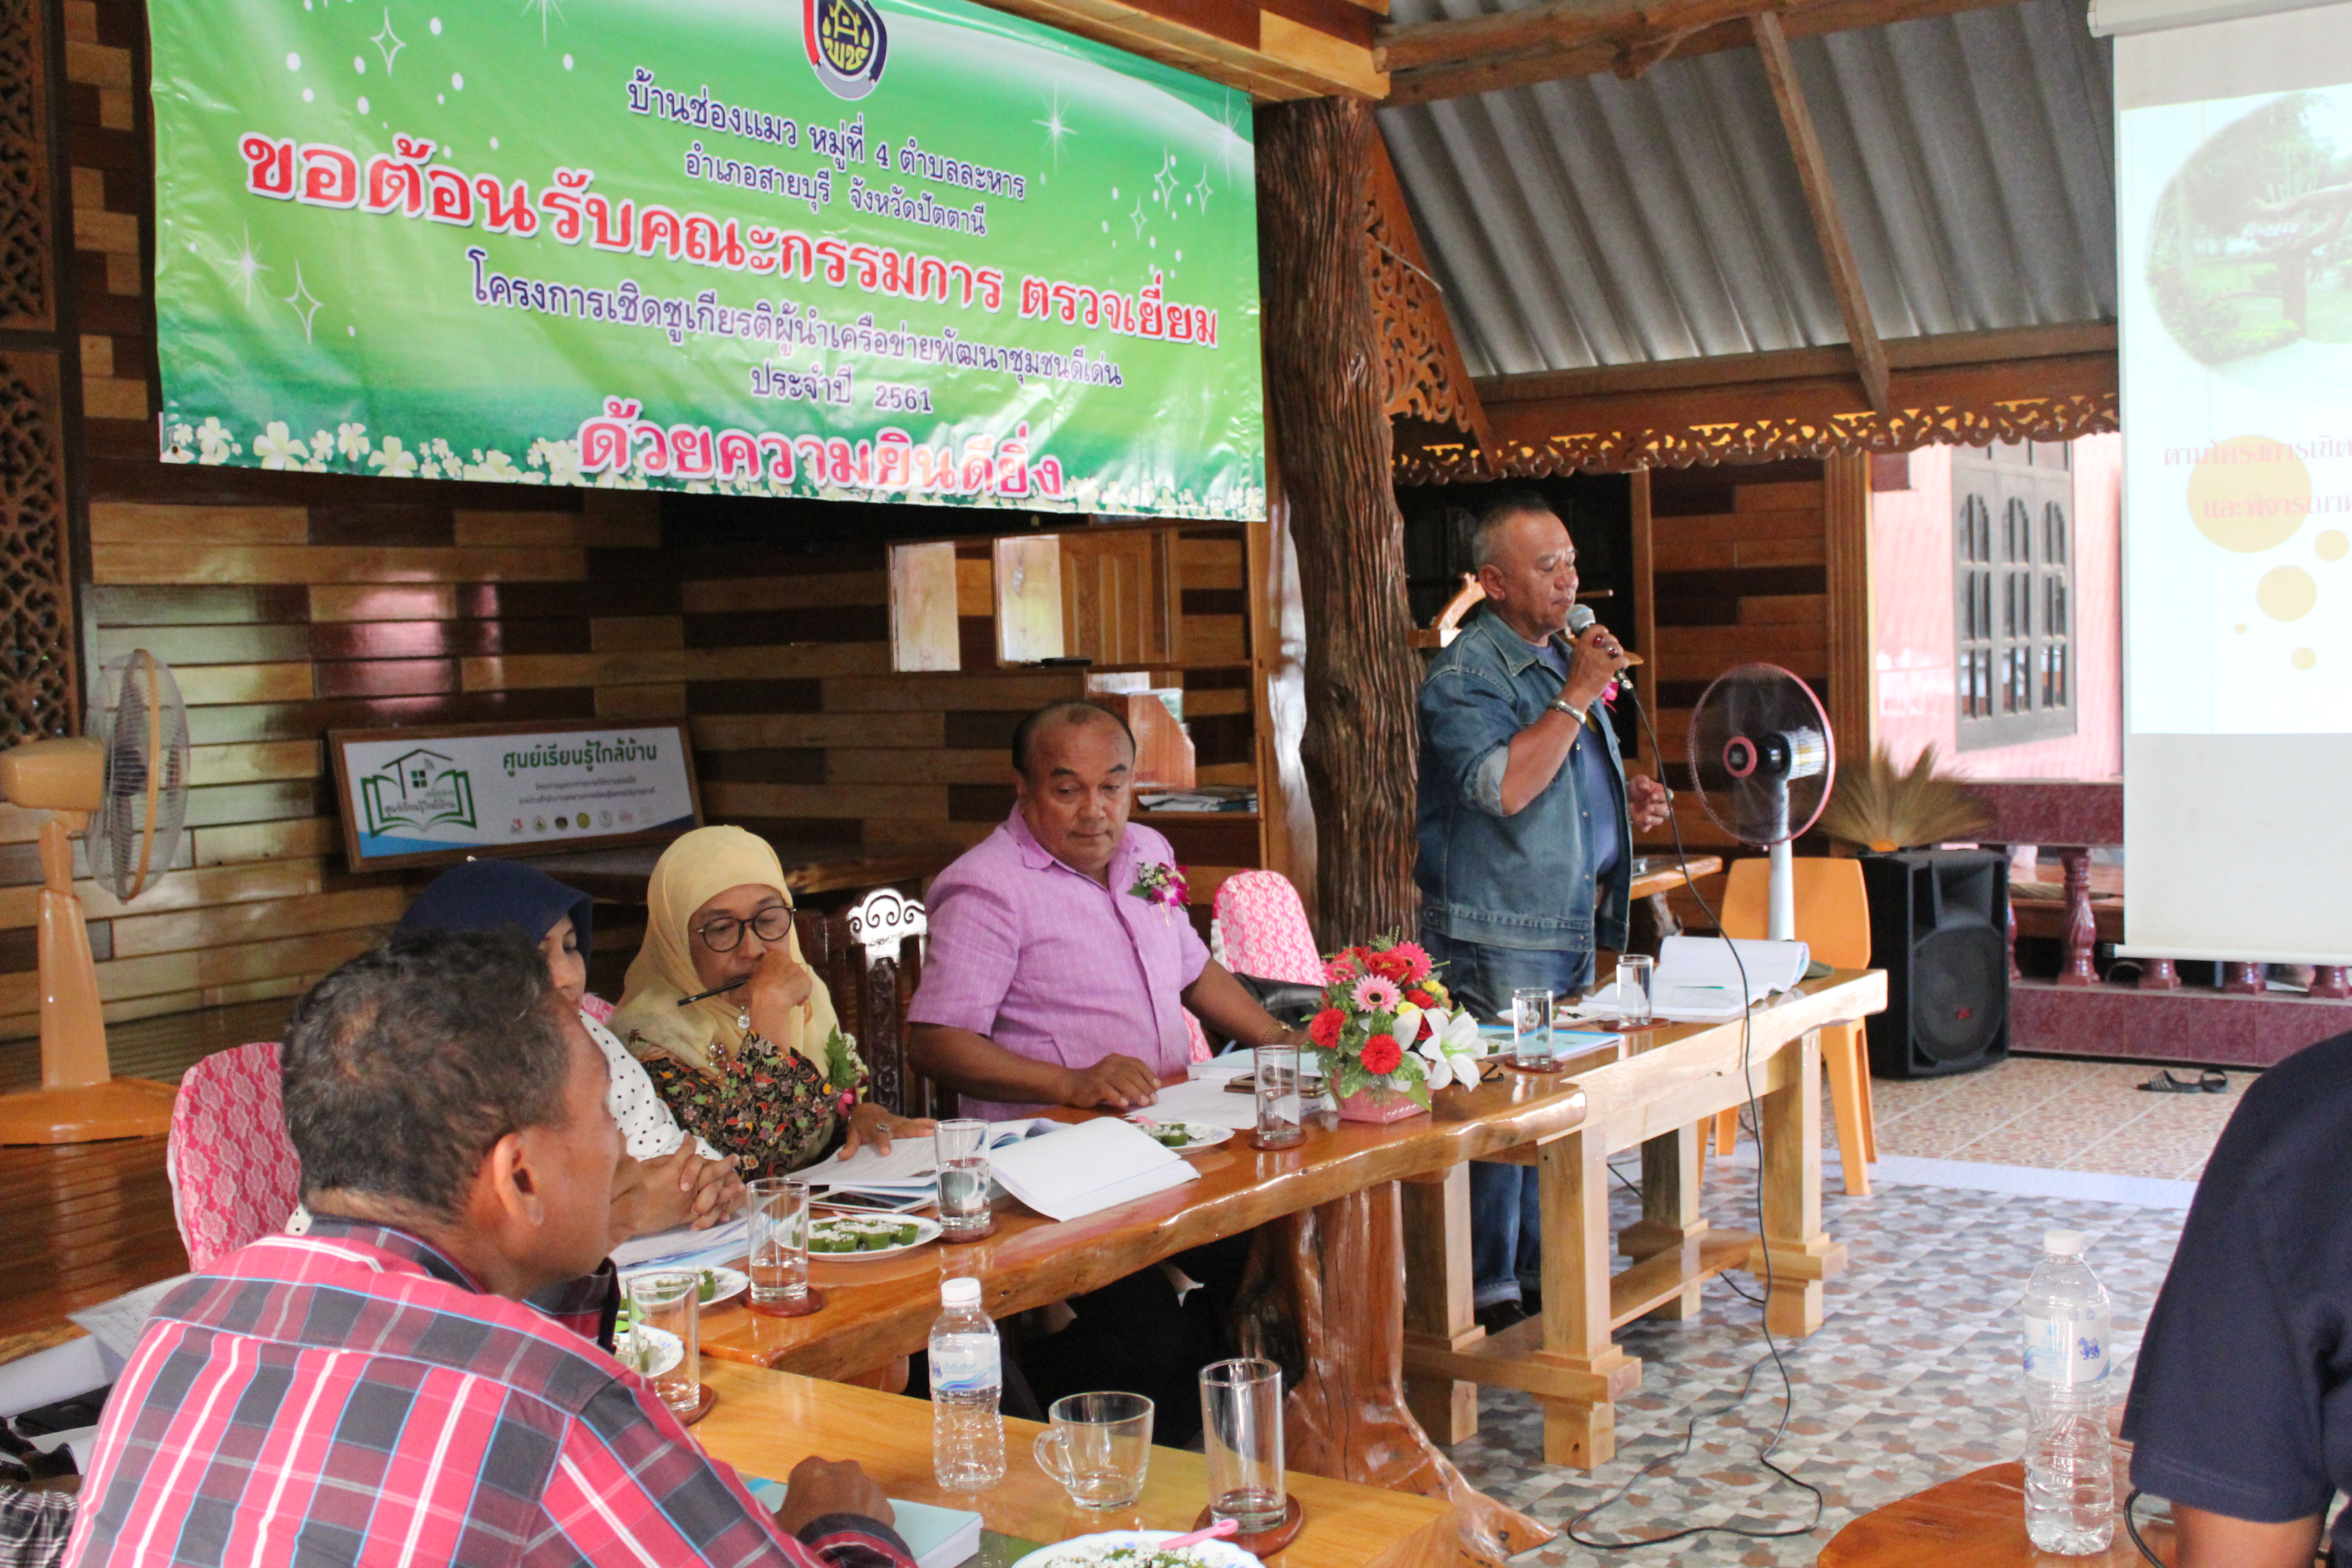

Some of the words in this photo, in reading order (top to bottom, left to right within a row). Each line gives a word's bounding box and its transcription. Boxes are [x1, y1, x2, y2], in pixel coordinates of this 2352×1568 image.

[628, 67, 796, 144] บ้านช่องแมว
[809, 114, 864, 172] หมู่ที่
[875, 145, 888, 166] 4
[900, 138, 1024, 200] ตำบลละหาร
[686, 144, 830, 212] อำเภอสายบุรี
[850, 178, 985, 235] จังหวัดปัตตานี
[242, 137, 1001, 311] ขอต้อนรับคณะกรรมการ
[1019, 274, 1218, 345] ตรวจเยี่ยม
[468, 250, 1122, 385] โครงการเชิดชูเกียรติผู้นำเครือข่ายพัฒนาชุมชนดีเด่น
[751, 362, 852, 404] ประจำปี
[874, 384, 932, 413] 2561
[581, 398, 1064, 497] ด้วยความยินดียิ่ง
[503, 738, 657, 777] ศูนย์เรียนรู้ใกล้บ้าน
